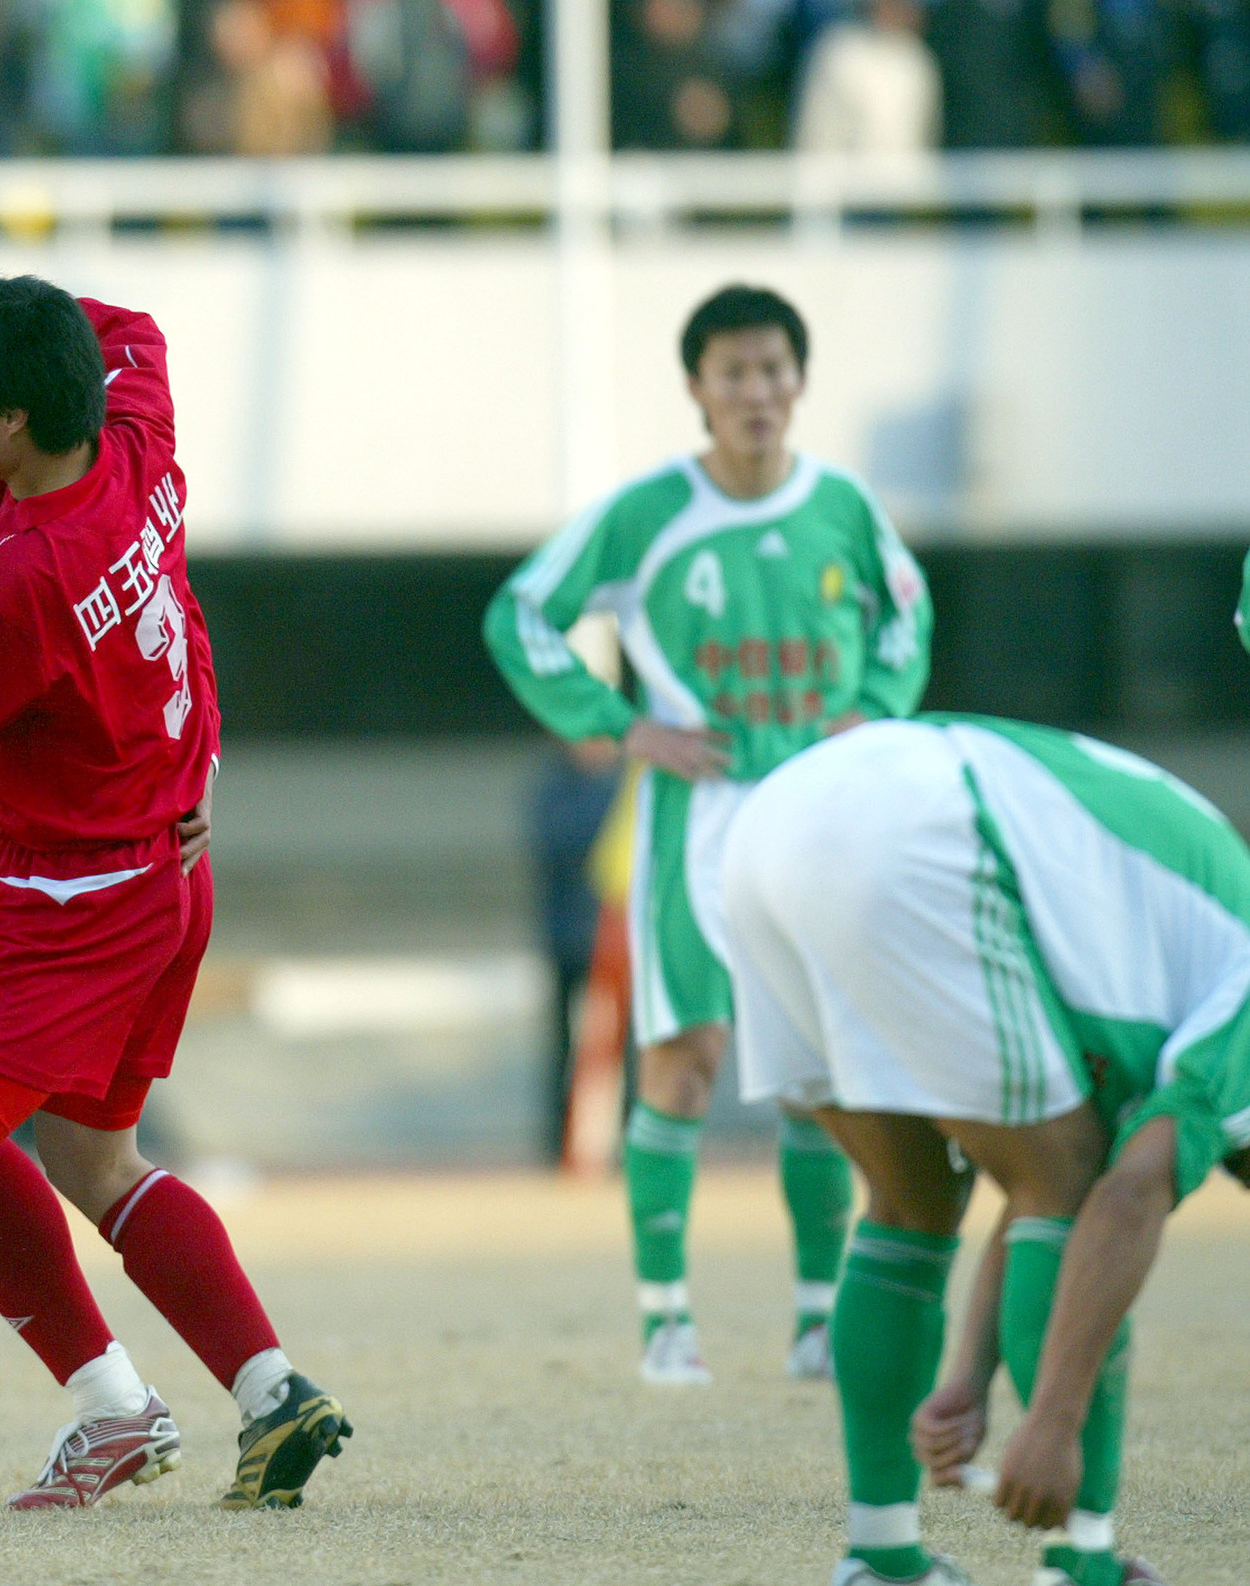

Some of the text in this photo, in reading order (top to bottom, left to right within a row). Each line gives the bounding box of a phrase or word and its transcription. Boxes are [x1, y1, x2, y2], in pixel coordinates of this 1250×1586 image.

[73, 472, 184, 652] 四五酒业
[683, 550, 727, 620] 4
